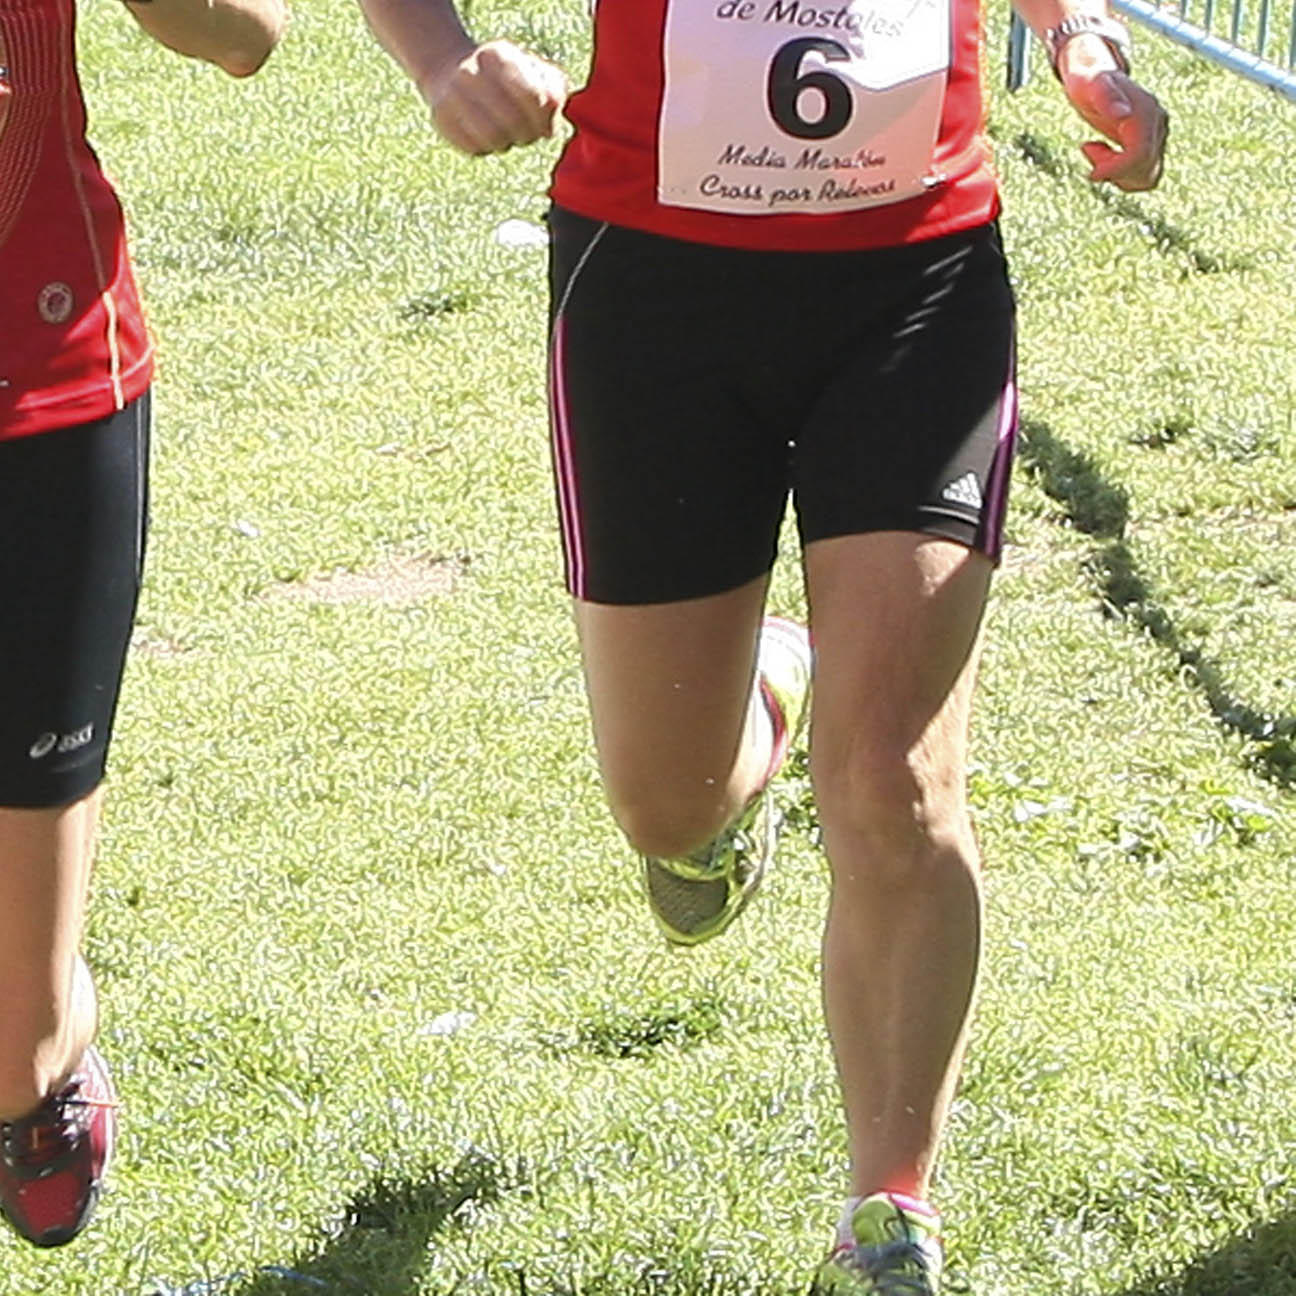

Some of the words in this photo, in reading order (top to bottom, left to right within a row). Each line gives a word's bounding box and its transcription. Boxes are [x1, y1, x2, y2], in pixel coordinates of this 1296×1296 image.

[763, 0, 904, 37] Mostoles
[767, 36, 854, 141] 6
[717, 144, 787, 169] Media
[699, 174, 764, 199] Cross
[769, 185, 812, 207] por
